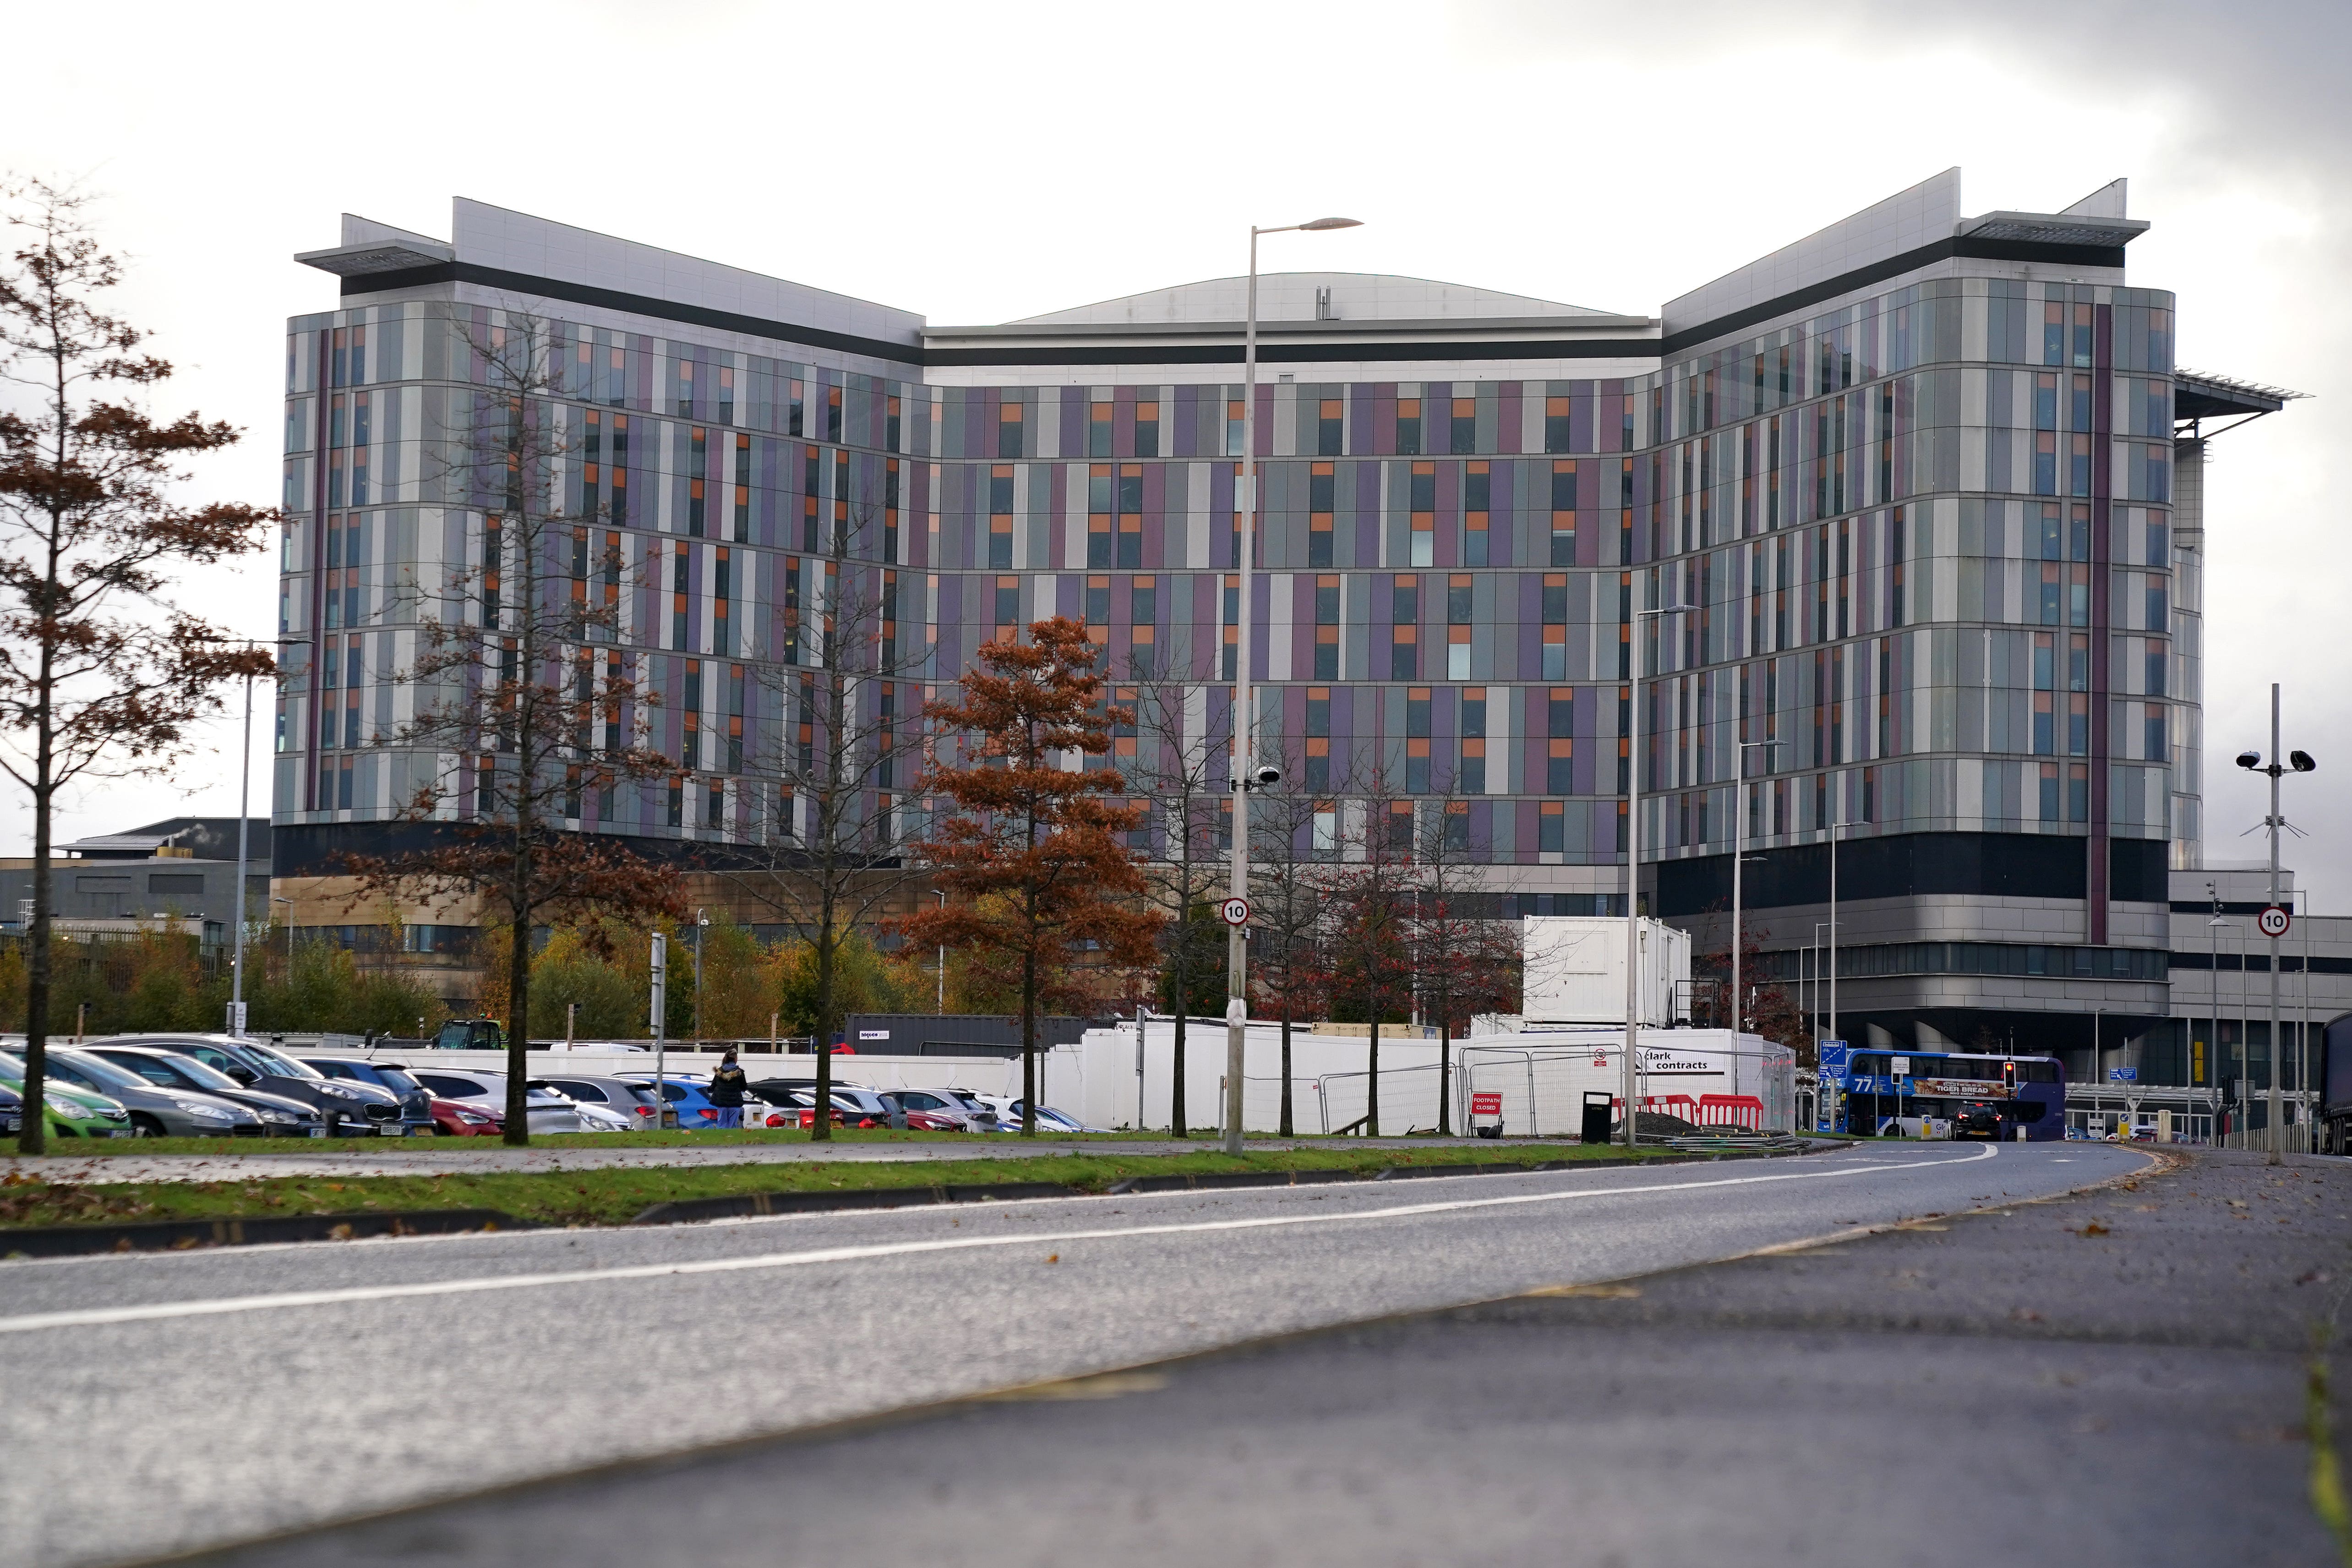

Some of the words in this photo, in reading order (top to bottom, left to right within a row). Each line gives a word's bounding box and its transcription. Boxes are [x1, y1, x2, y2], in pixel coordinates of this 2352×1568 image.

[1228, 906, 1244, 917] 10
[2266, 915, 2284, 927] 10
[1855, 1078, 1872, 1092] 77
